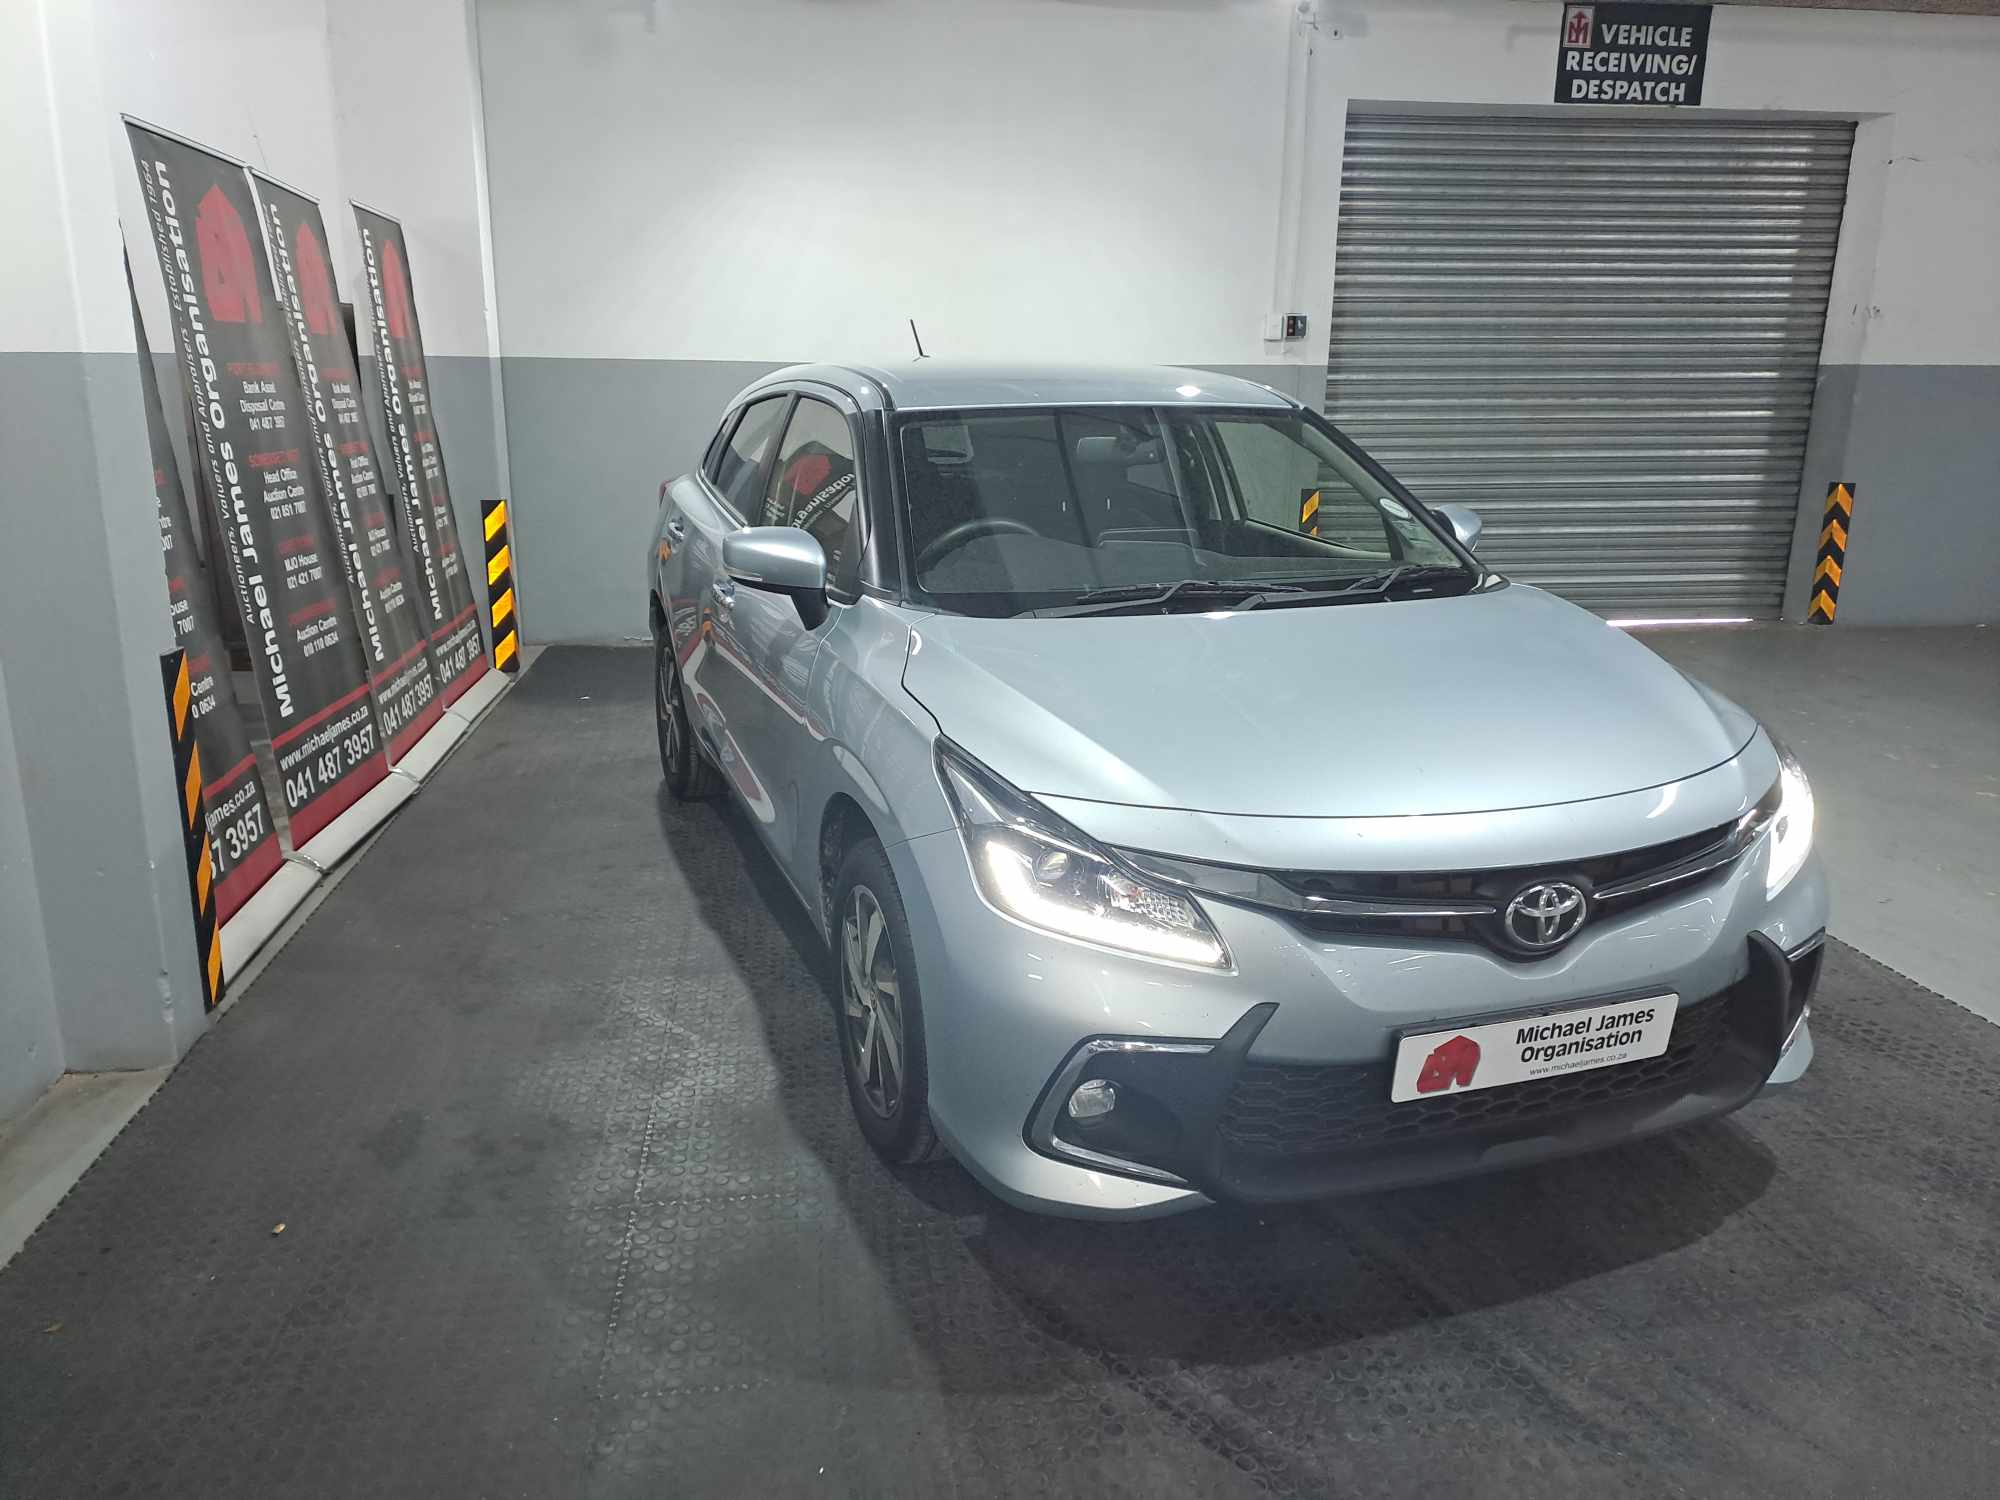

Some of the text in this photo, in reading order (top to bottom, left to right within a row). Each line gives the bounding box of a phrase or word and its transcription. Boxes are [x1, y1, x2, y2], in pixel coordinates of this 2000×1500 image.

[1566, 51, 1698, 75] RECEIVING/
[1601, 24, 1693, 47] VEHICLE
[1571, 79, 1686, 102] DESPATCH
[151, 208, 183, 311] Established
[270, 204, 326, 422] Organisation
[362, 228, 402, 415] Organisation
[181, 327, 208, 417] Appraisers
[155, 160, 294, 718] Michael James Organisation
[200, 421, 216, 454] and
[398, 423, 422, 510] James
[211, 459, 231, 519] Valuers
[323, 432, 354, 534] James
[415, 518, 442, 620] Michael
[170, 599, 188, 616] ouse
[348, 543, 385, 661] Michael
[440, 656, 456, 684] 041
[455, 646, 467, 671] 487
[383, 673, 434, 735] 041 487 3957
[280, 705, 369, 771] www.michaeljames.co.za
[286, 723, 375, 808] 041 487 3957
[204, 780, 257, 836] ljames.co.za
[225, 802, 264, 860] 3957
[1516, 1008, 1655, 1044] Michael James
[1521, 1029, 1642, 1062] Organisation
